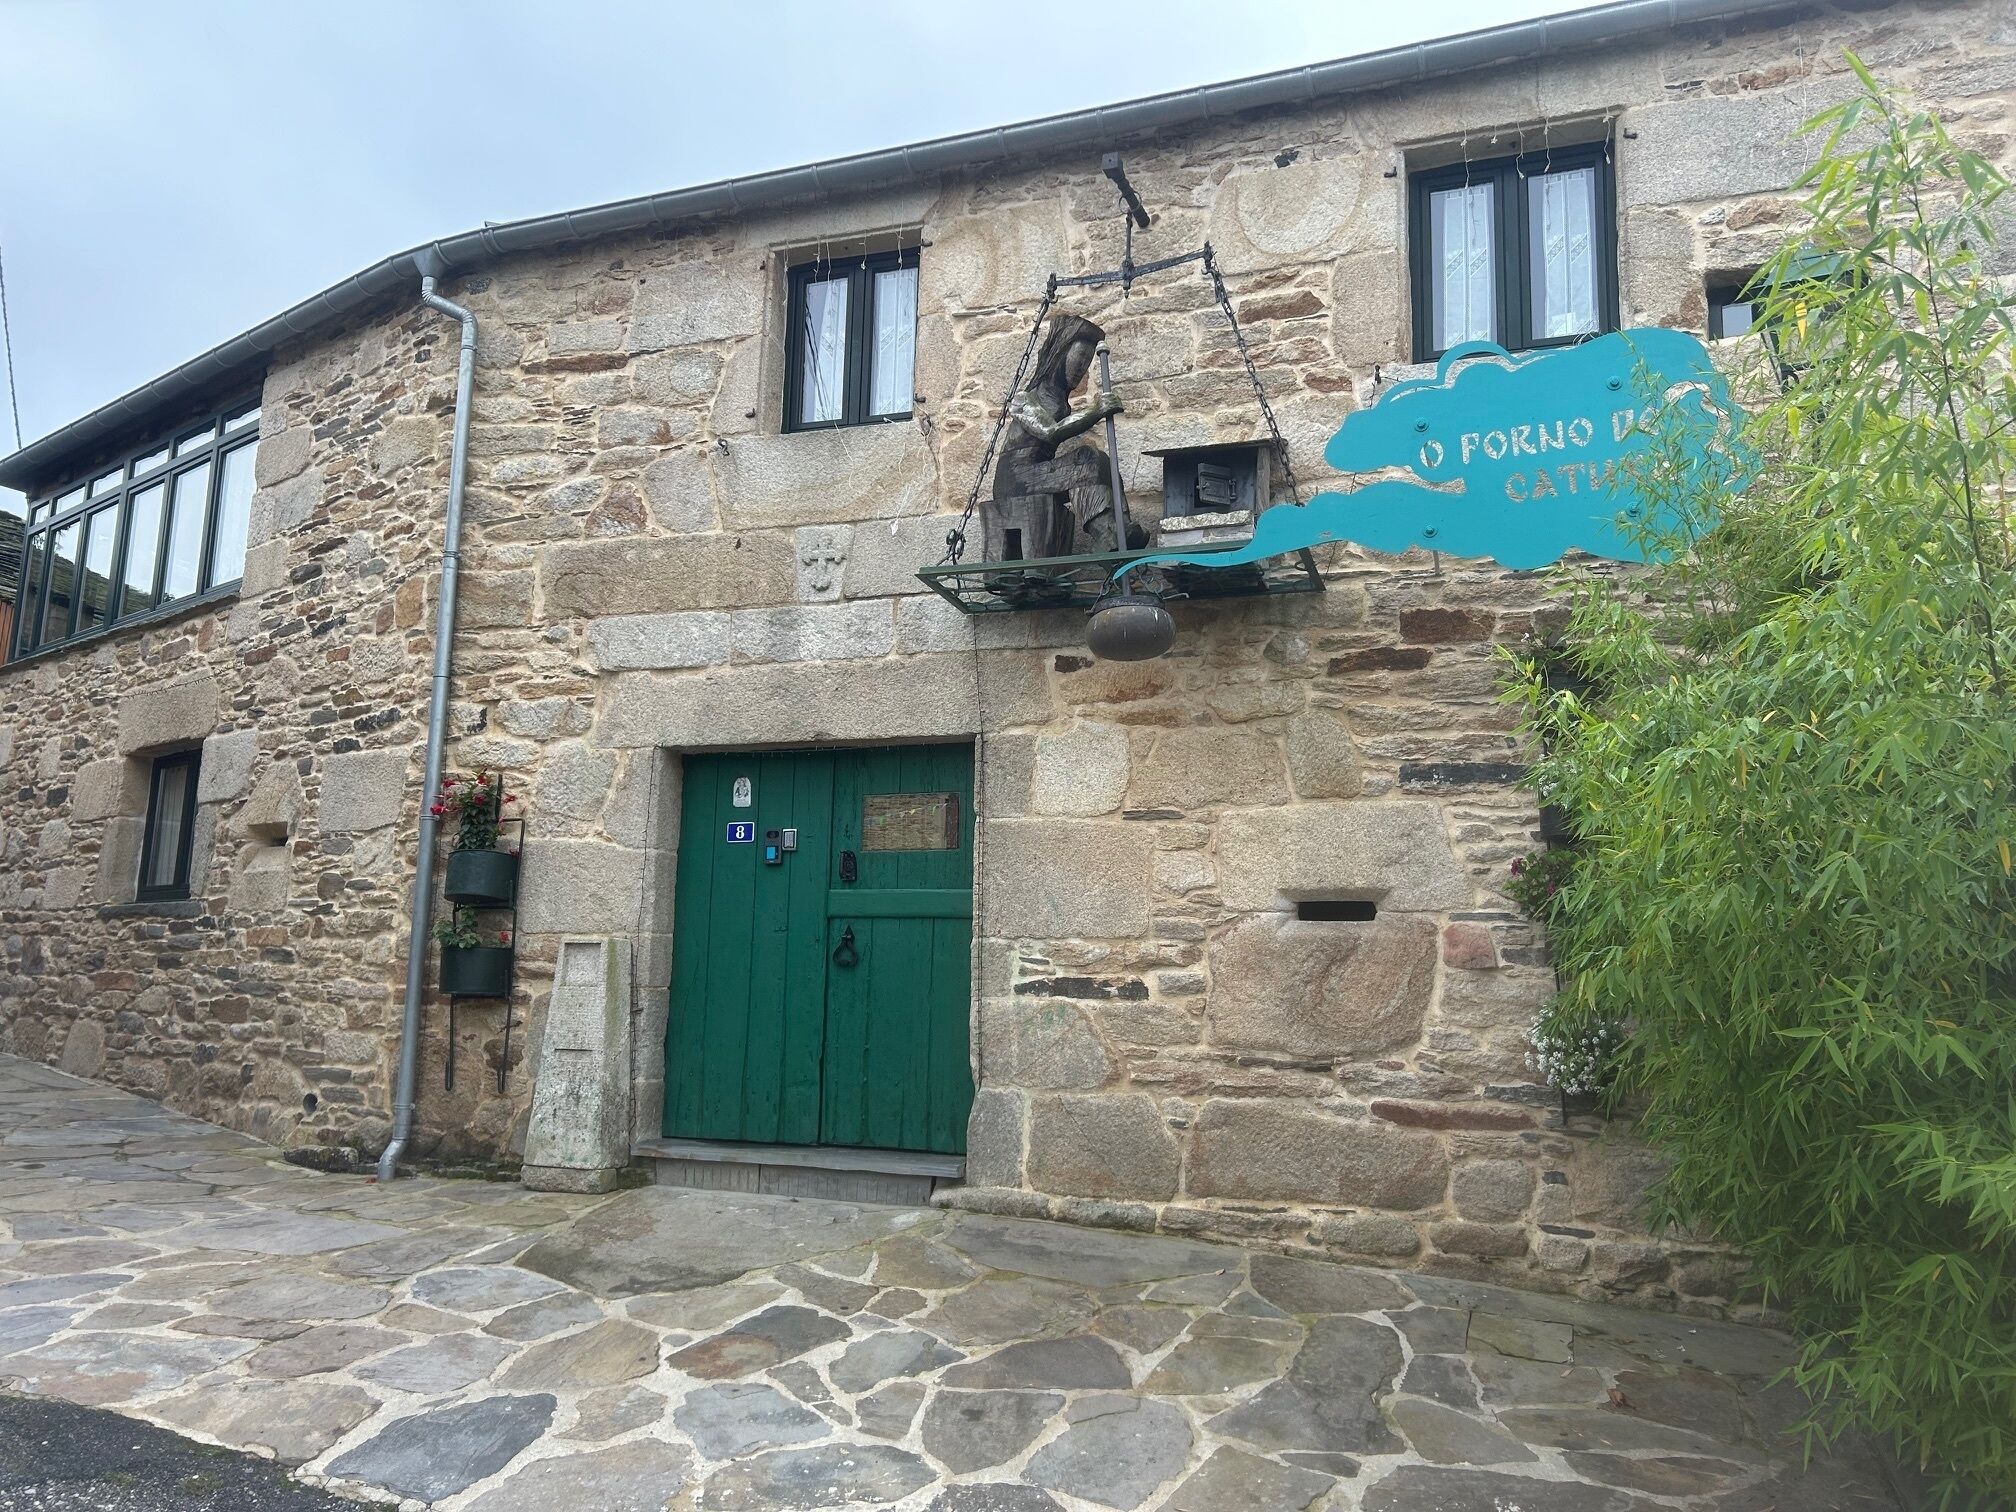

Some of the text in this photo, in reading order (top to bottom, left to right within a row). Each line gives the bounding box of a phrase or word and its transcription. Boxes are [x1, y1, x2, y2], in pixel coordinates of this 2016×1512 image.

[1419, 439, 1444, 469] O
[1460, 416, 1593, 465] FORNO
[735, 825, 745, 839] 8
